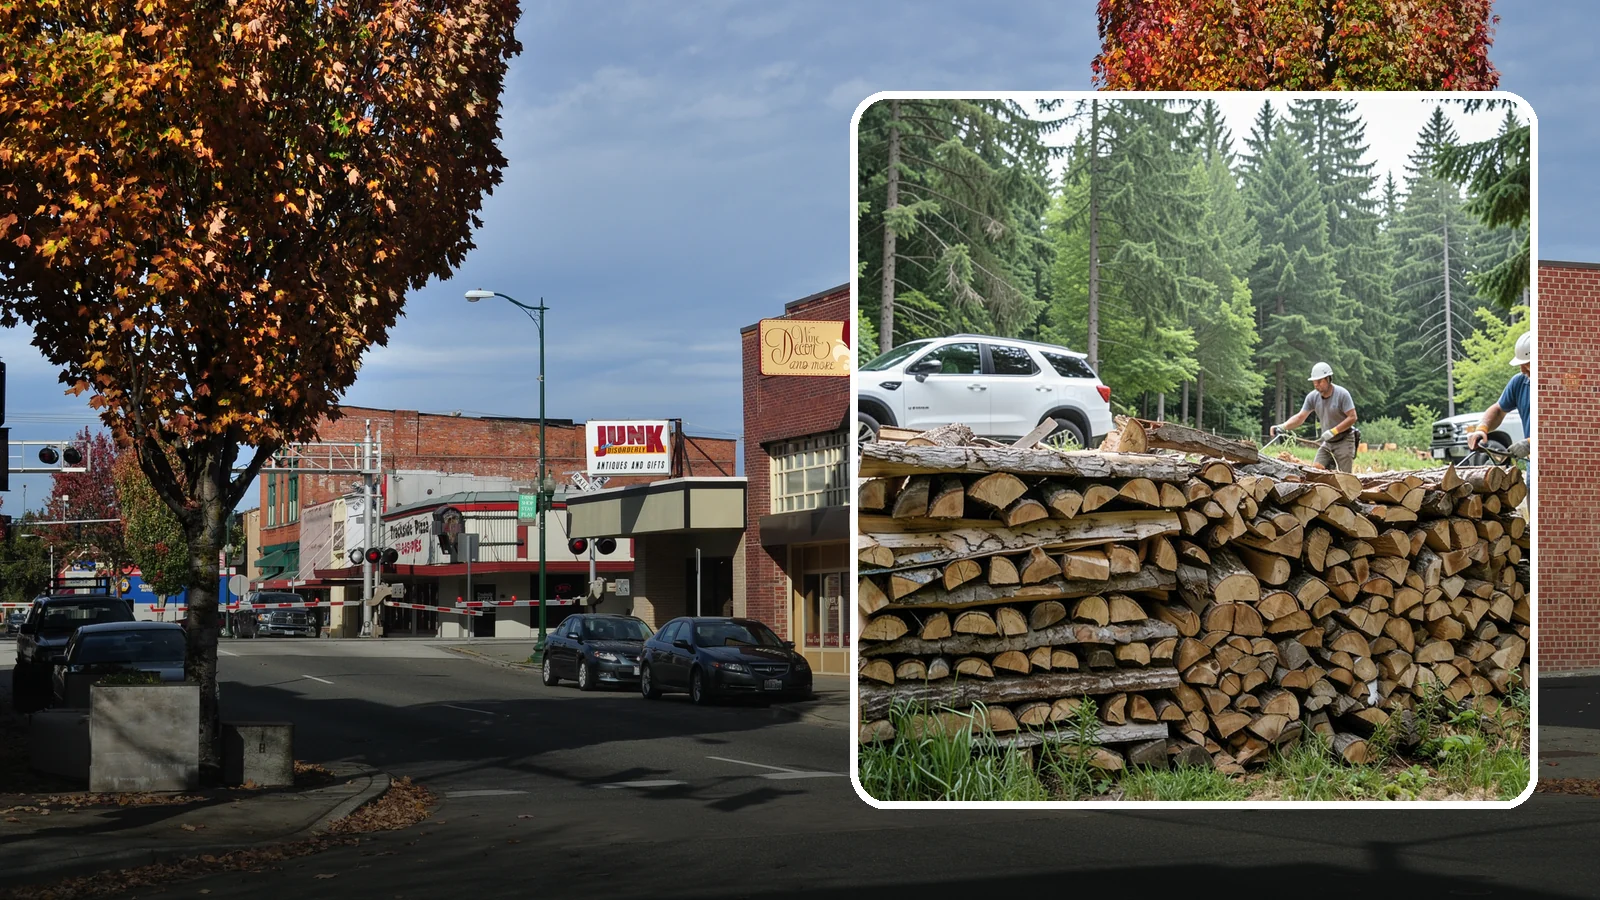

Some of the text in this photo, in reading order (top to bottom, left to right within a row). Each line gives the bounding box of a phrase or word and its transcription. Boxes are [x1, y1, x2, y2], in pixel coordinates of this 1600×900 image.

[595, 425, 665, 457] JUNK
[607, 445, 646, 454] DISORDERLY
[596, 460, 665, 470] ANTIQUES AND GIFTS
[590, 476, 608, 491] SING
[352, 498, 364, 511] CRO
[390, 519, 429, 540] Trackside Pizza
